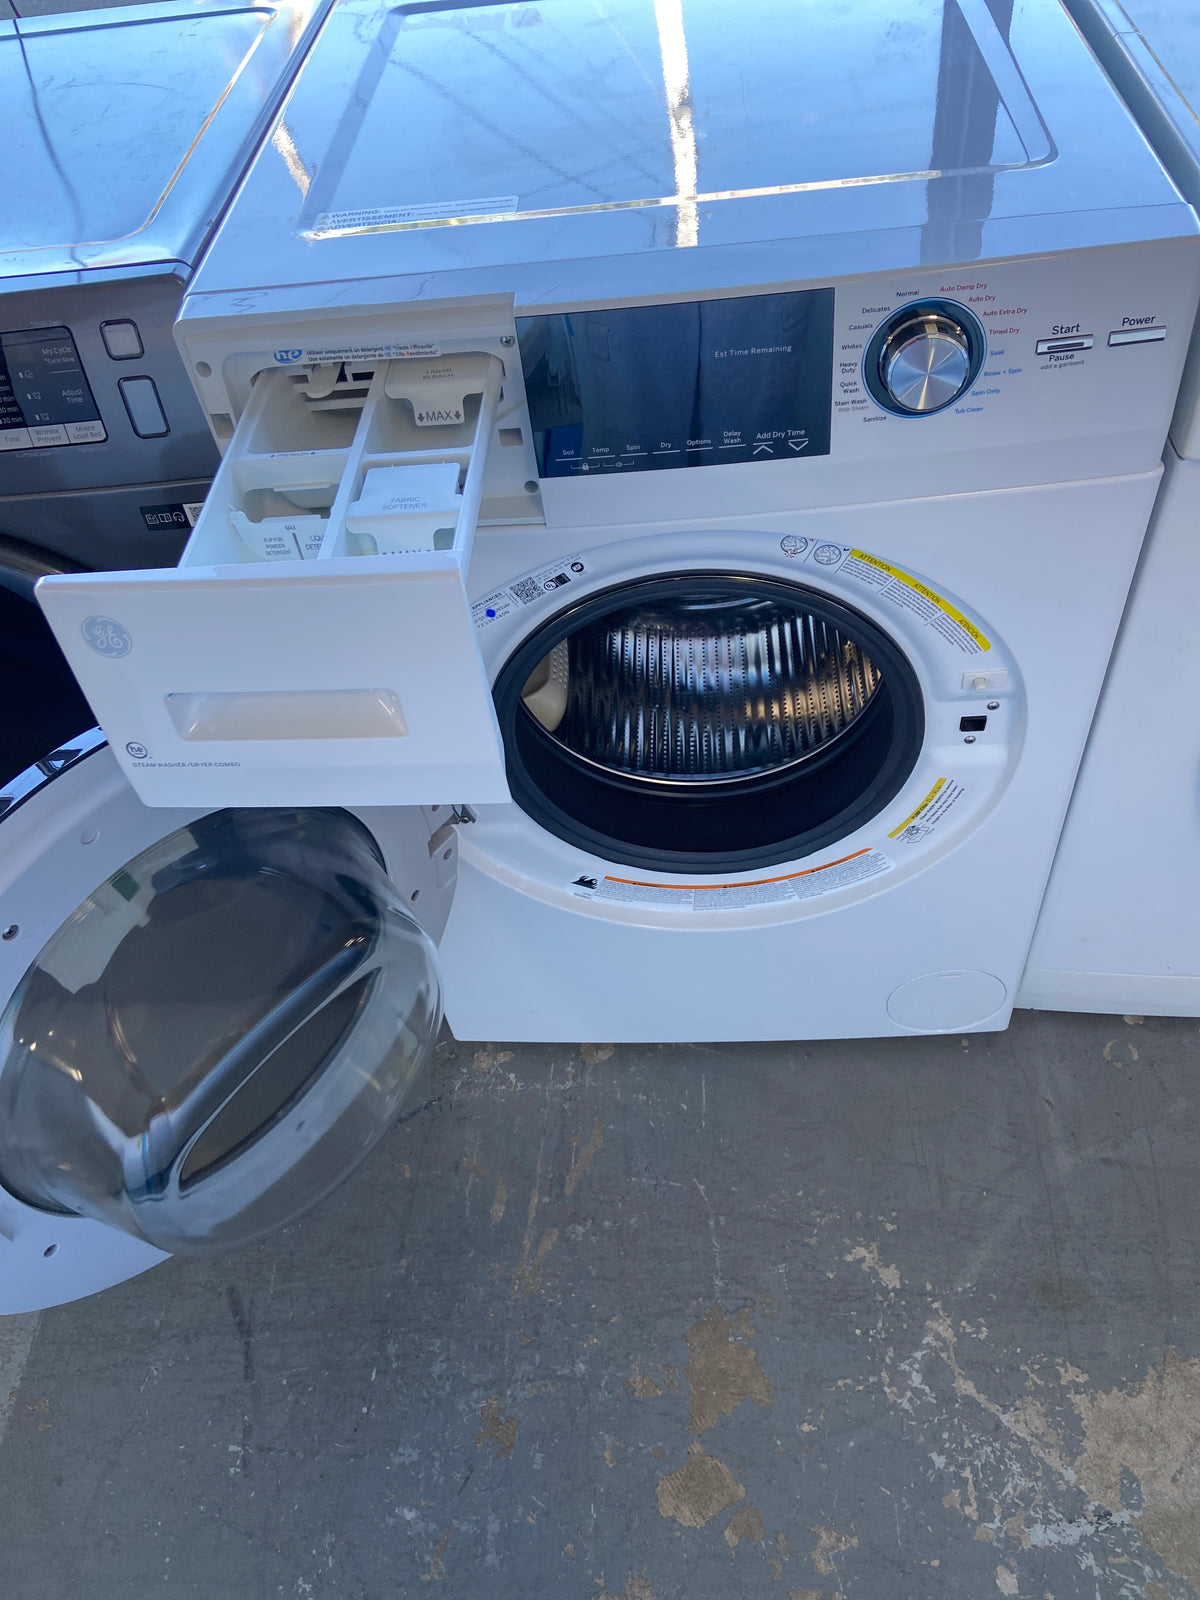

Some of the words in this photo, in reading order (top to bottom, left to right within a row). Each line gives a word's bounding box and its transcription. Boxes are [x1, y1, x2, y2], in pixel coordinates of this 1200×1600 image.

[329, 213, 414, 224] AVERTISSEMENT:
[331, 210, 381, 218] WARNING:
[1122, 315, 1156, 326] Power
[1052, 323, 1080, 335] Start
[54, 346, 72, 355] Cycle
[751, 345, 792, 355] Remaining
[1049, 354, 1075, 362] Pause
[1058, 360, 1085, 369] garment
[62, 389, 83, 398] Adjust
[426, 410, 453, 421] MAX
[773, 431, 786, 439] Dry
[687, 439, 712, 447] Options
[592, 447, 609, 455] Temp
[858, 554, 892, 572] ATTENTION
[913, 583, 942, 604] ATTENTION
[472, 592, 502, 610] APPLIANCES
